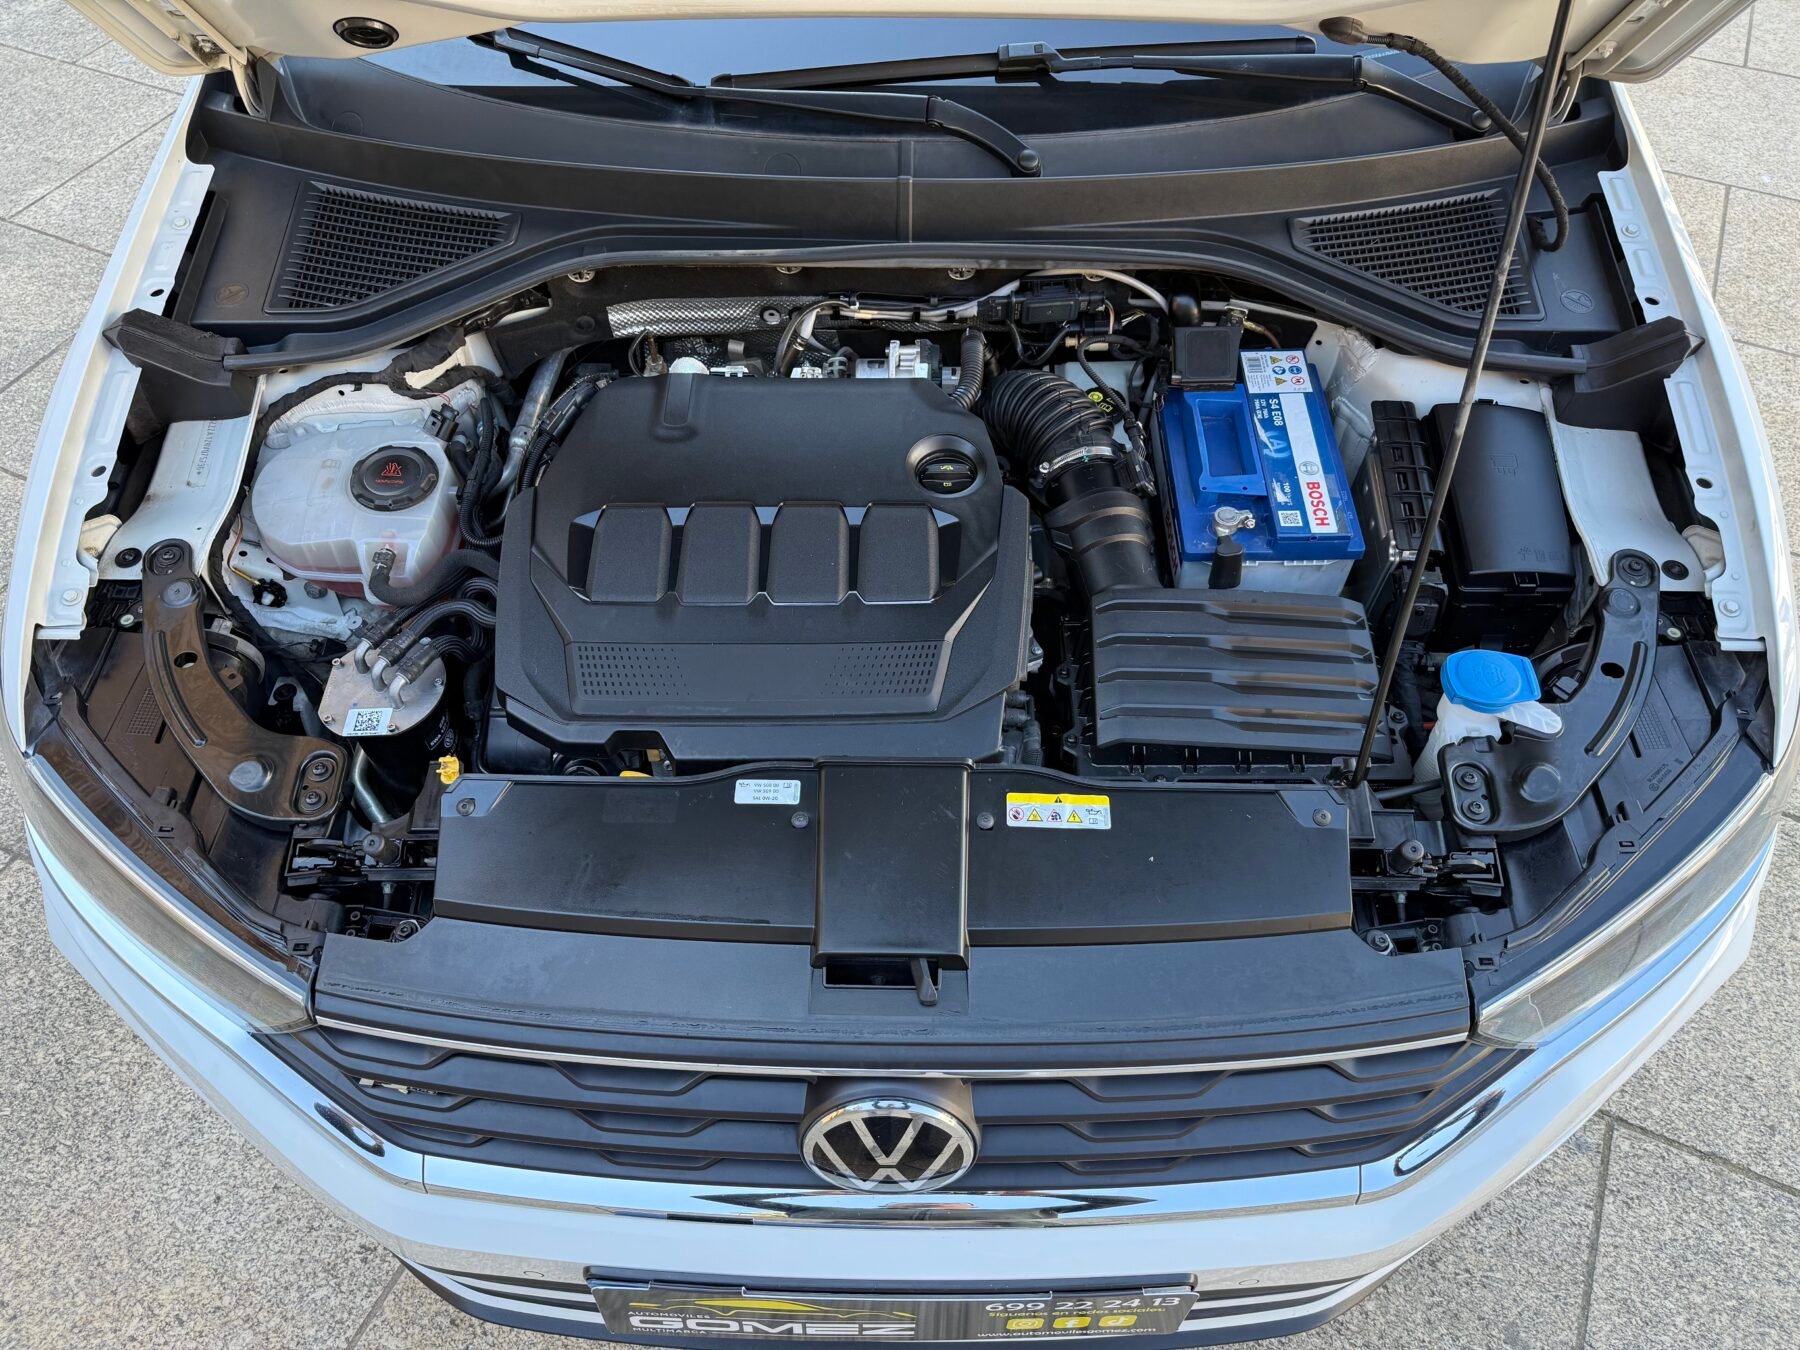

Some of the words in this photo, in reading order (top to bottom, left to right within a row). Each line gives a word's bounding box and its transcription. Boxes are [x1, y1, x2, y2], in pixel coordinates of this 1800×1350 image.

[1269, 398, 1280, 409] S4
[1271, 411, 1284, 426] E08
[1306, 481, 1330, 526] BOSCH
[985, 1302, 1045, 1312] 699
[1054, 1301, 1094, 1310] 22
[1102, 1298, 1141, 1309] 24
[1151, 1297, 1181, 1307] 13
[627, 1311, 711, 1319] AUTOMOVILES
[629, 1316, 916, 1335] GOMEZ
[632, 1327, 708, 1335] MULTIMARCA
[977, 1327, 1157, 1338] www.automovilesgomez.com
